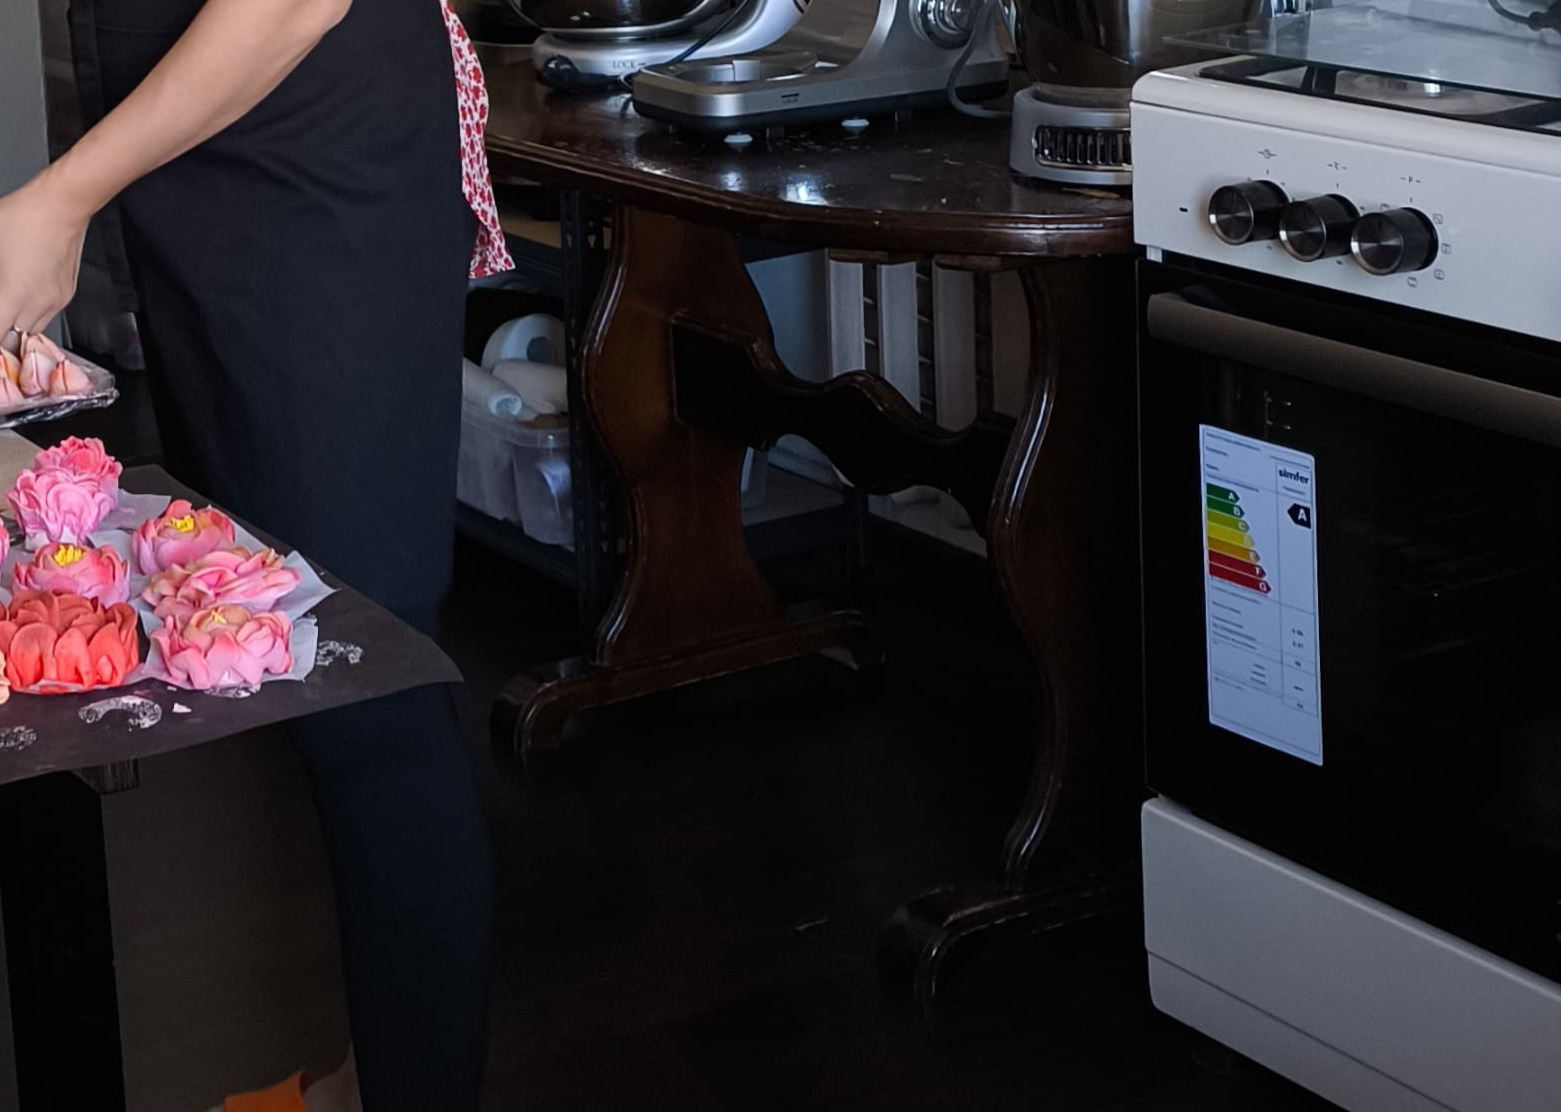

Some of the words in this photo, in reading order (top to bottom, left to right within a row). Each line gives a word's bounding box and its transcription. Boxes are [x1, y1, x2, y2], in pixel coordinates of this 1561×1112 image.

[1278, 468, 1310, 485] simfer
[1228, 492, 1236, 502] A
[1233, 504, 1241, 515] B
[1298, 508, 1308, 522] A
[1238, 521, 1246, 532] C
[1256, 567, 1262, 577] F
[1259, 580, 1267, 591] G
